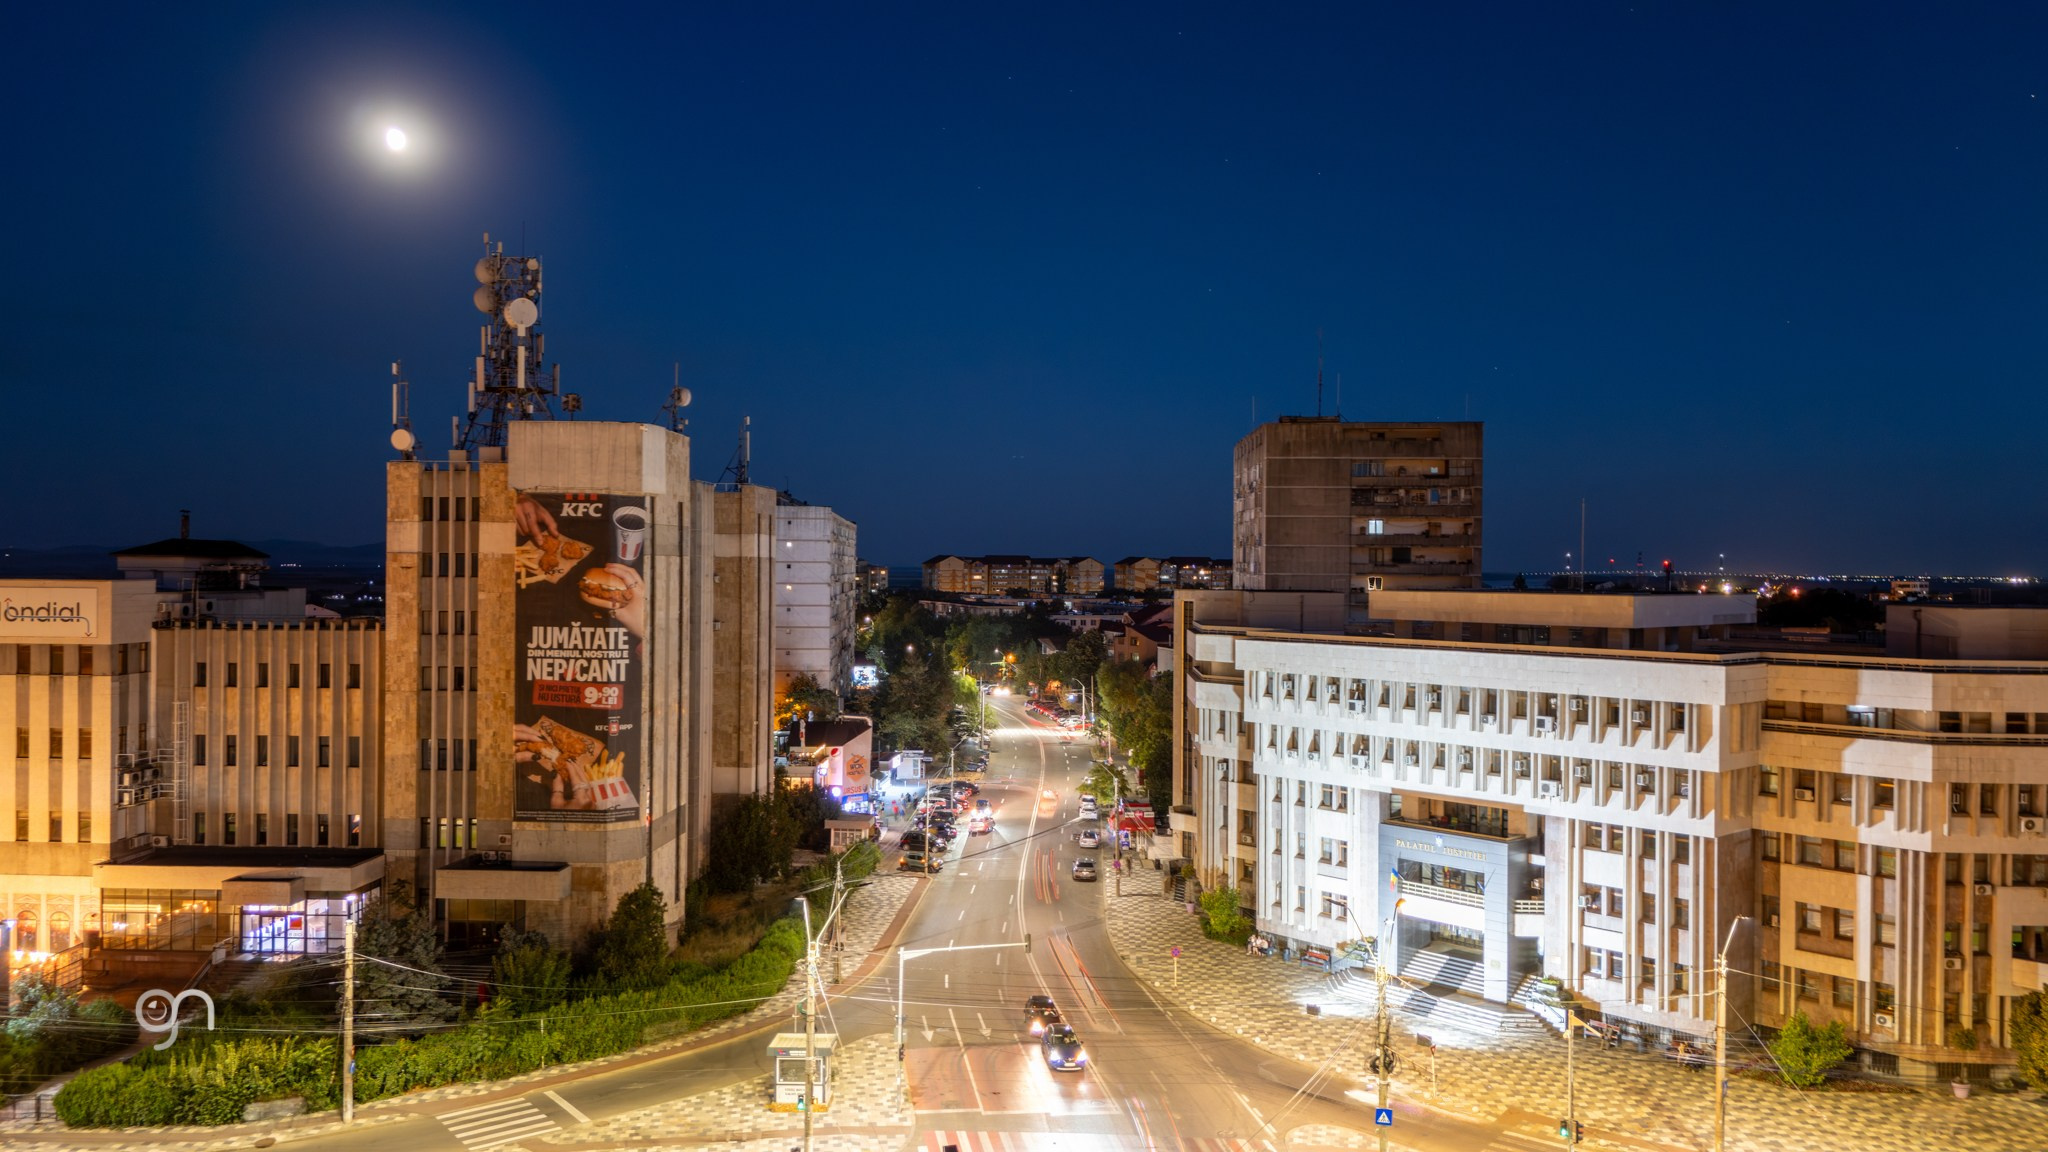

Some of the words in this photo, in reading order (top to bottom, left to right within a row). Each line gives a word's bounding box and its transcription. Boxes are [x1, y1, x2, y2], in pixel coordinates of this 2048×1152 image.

[560, 502, 603, 517] KFC
[0, 602, 80, 622] ondial
[527, 621, 629, 650] JUMĂTATE
[527, 649, 545, 658] DIN
[546, 649, 581, 658] MENIUL
[583, 650, 621, 659] NOSTRU
[622, 650, 629, 658] E
[527, 658, 630, 682] NEPICANT
[538, 692, 549, 702] NU
[602, 696, 618, 705] LEI
[595, 724, 609, 732] KFC
[1396, 839, 1436, 854] PALATUL
